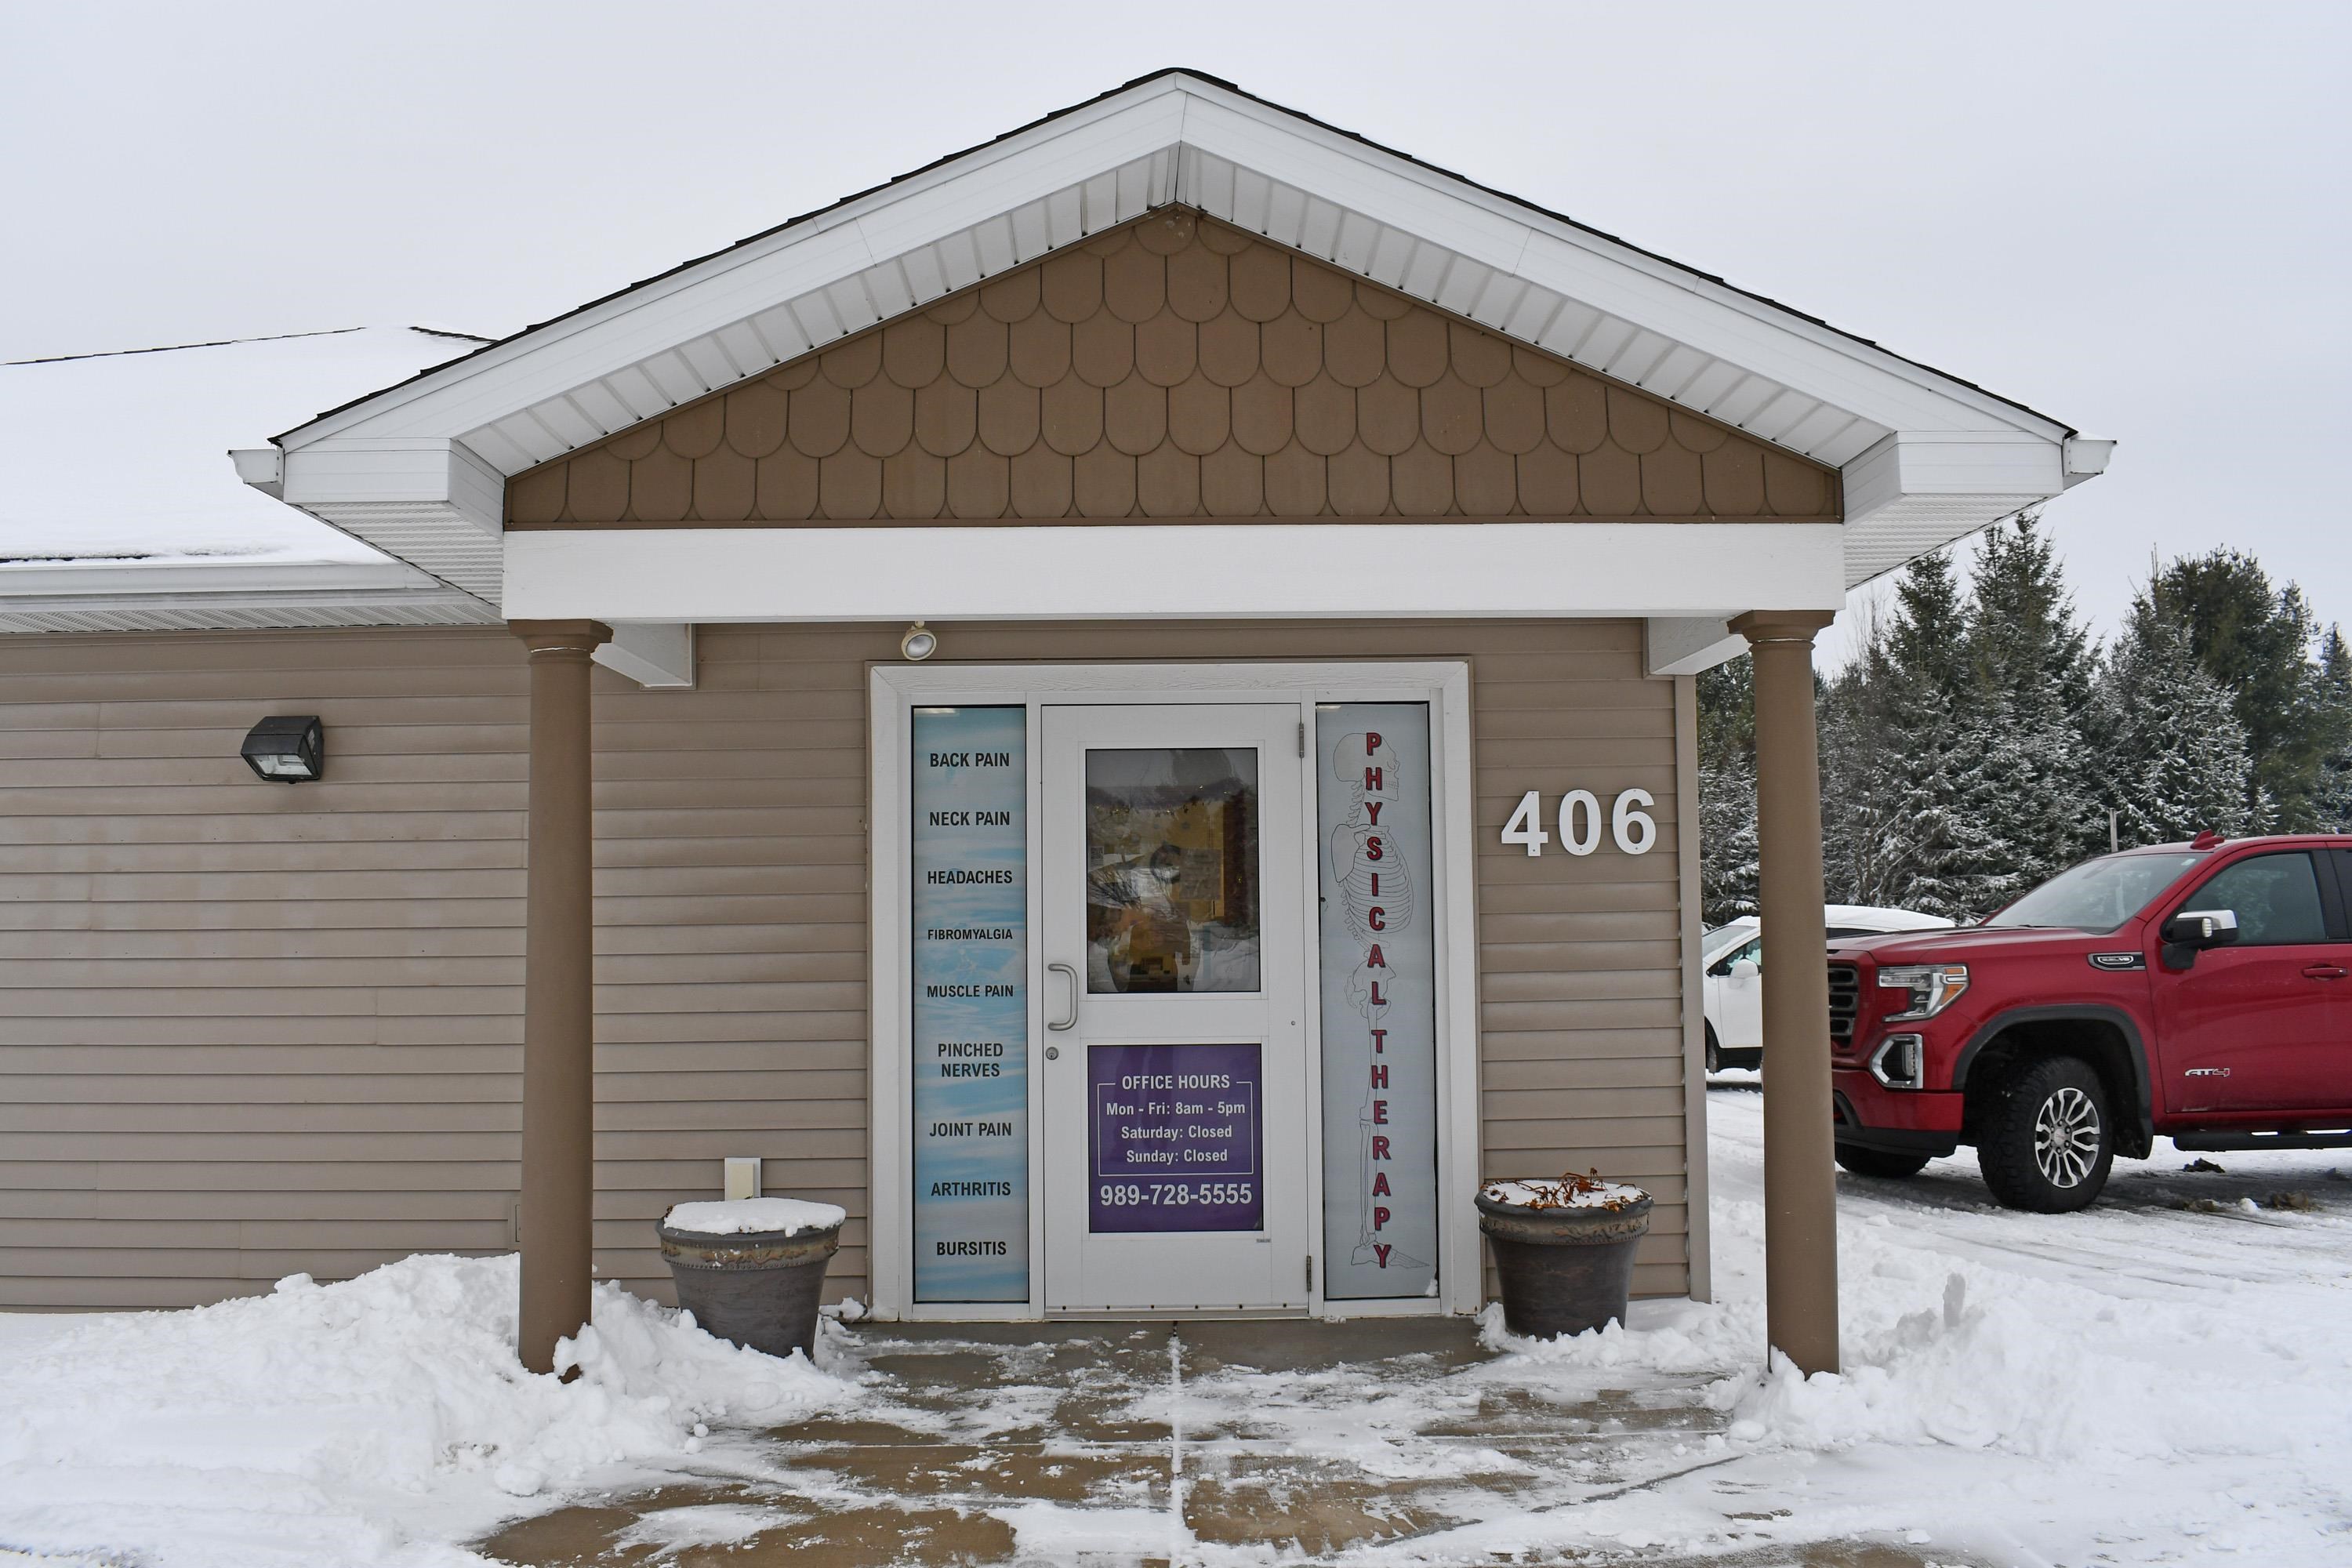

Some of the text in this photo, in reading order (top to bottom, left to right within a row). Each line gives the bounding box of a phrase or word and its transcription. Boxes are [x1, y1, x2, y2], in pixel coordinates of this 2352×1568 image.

[930, 752, 1010, 768] BACK PAIN
[929, 811, 1010, 826] NECK PAIN
[1501, 788, 1657, 857] 406
[927, 870, 1013, 884] HEADACHES
[927, 928, 1013, 940] FIBROMYALGIA
[927, 985, 1014, 998] MUSCLE PAIN
[1364, 732, 1392, 1269] PHYSICAL THERAPY
[938, 1043, 1004, 1058] PINCHED
[941, 1062, 1000, 1077] NERVES
[2184, 1068, 2230, 1077] AT4
[1122, 1074, 1230, 1090] OFFICE HOURS
[1106, 1102, 1134, 1116] Mon
[1149, 1102, 1171, 1115] Fri:
[1175, 1102, 1203, 1115] 8am
[1218, 1101, 1246, 1117] 5pm
[929, 1122, 1011, 1137] JOINT PAIN
[1121, 1124, 1232, 1142] Saturday: Closed
[1127, 1149, 1228, 1166] Sunday: Closed
[931, 1181, 1011, 1196] ARTHRITIS
[1100, 1183, 1252, 1206] 989-728-5555
[936, 1241, 1007, 1256] BURSITIS
